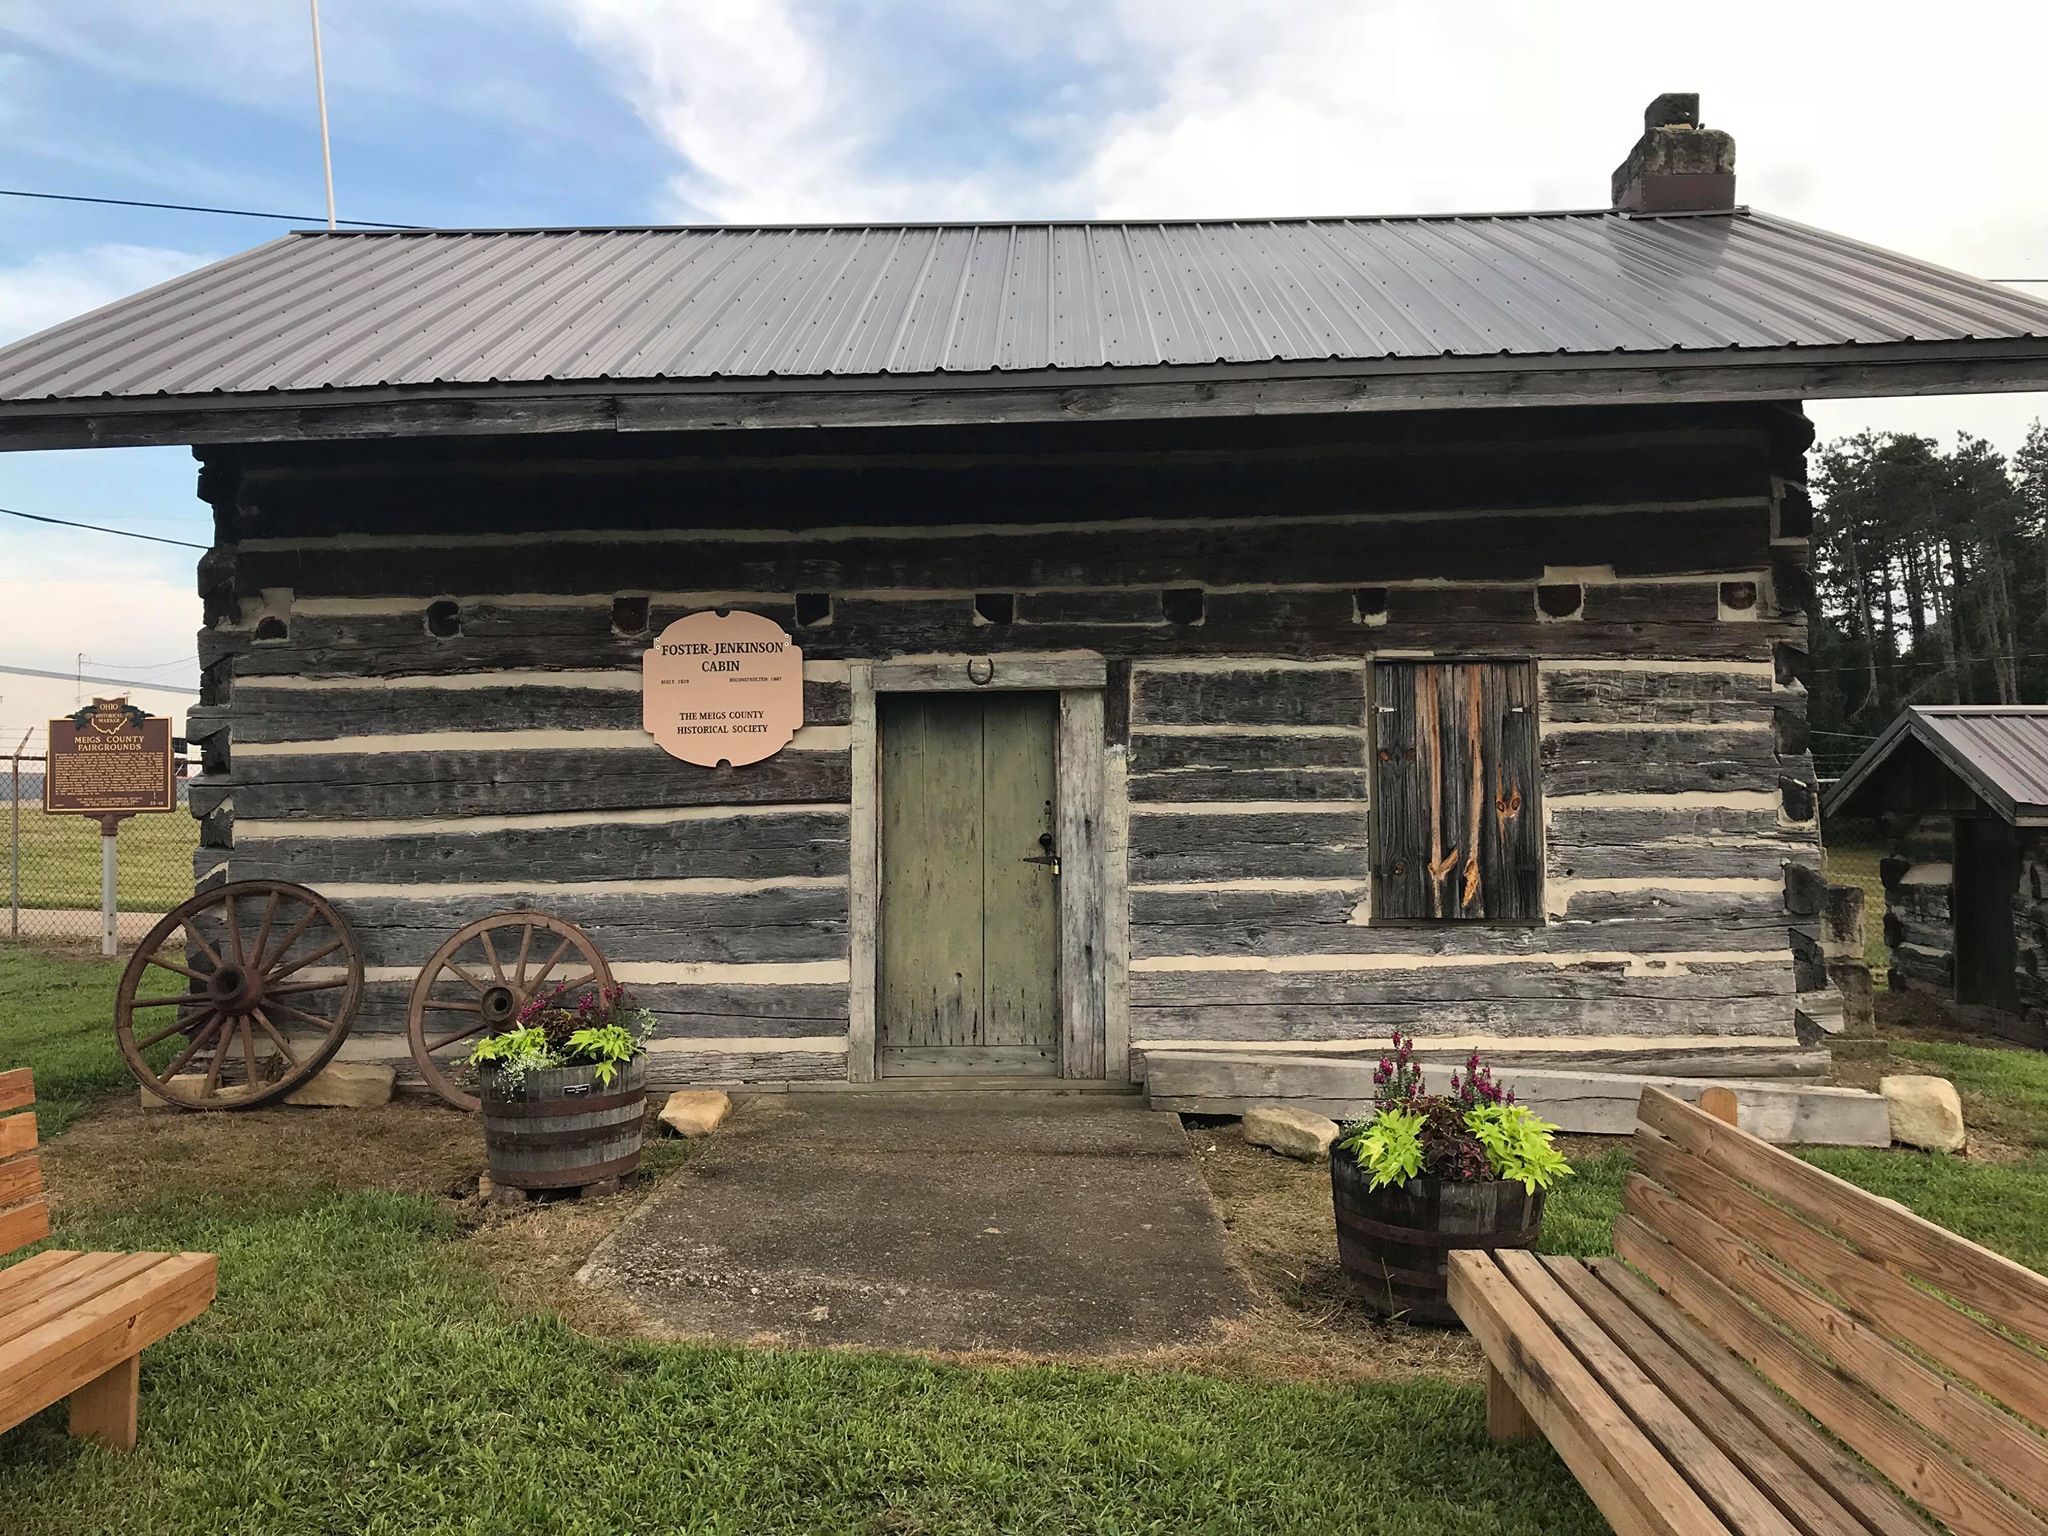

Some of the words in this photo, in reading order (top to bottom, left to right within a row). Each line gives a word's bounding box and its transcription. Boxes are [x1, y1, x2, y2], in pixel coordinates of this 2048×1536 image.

[661, 642, 784, 656] FOSTER-JENKINSON
[701, 660, 740, 672] CABIN
[100, 703, 118, 711] OHIO
[679, 712, 697, 720] THE
[699, 711, 726, 720] MEIGS
[729, 711, 764, 719] COUNTY
[677, 725, 728, 735] HISTORICAL
[732, 724, 768, 734] SOCIETY
[74, 736, 101, 744] MEIGS
[106, 735, 145, 743] COUNTY
[78, 743, 142, 752] FAIRGROUNDS
